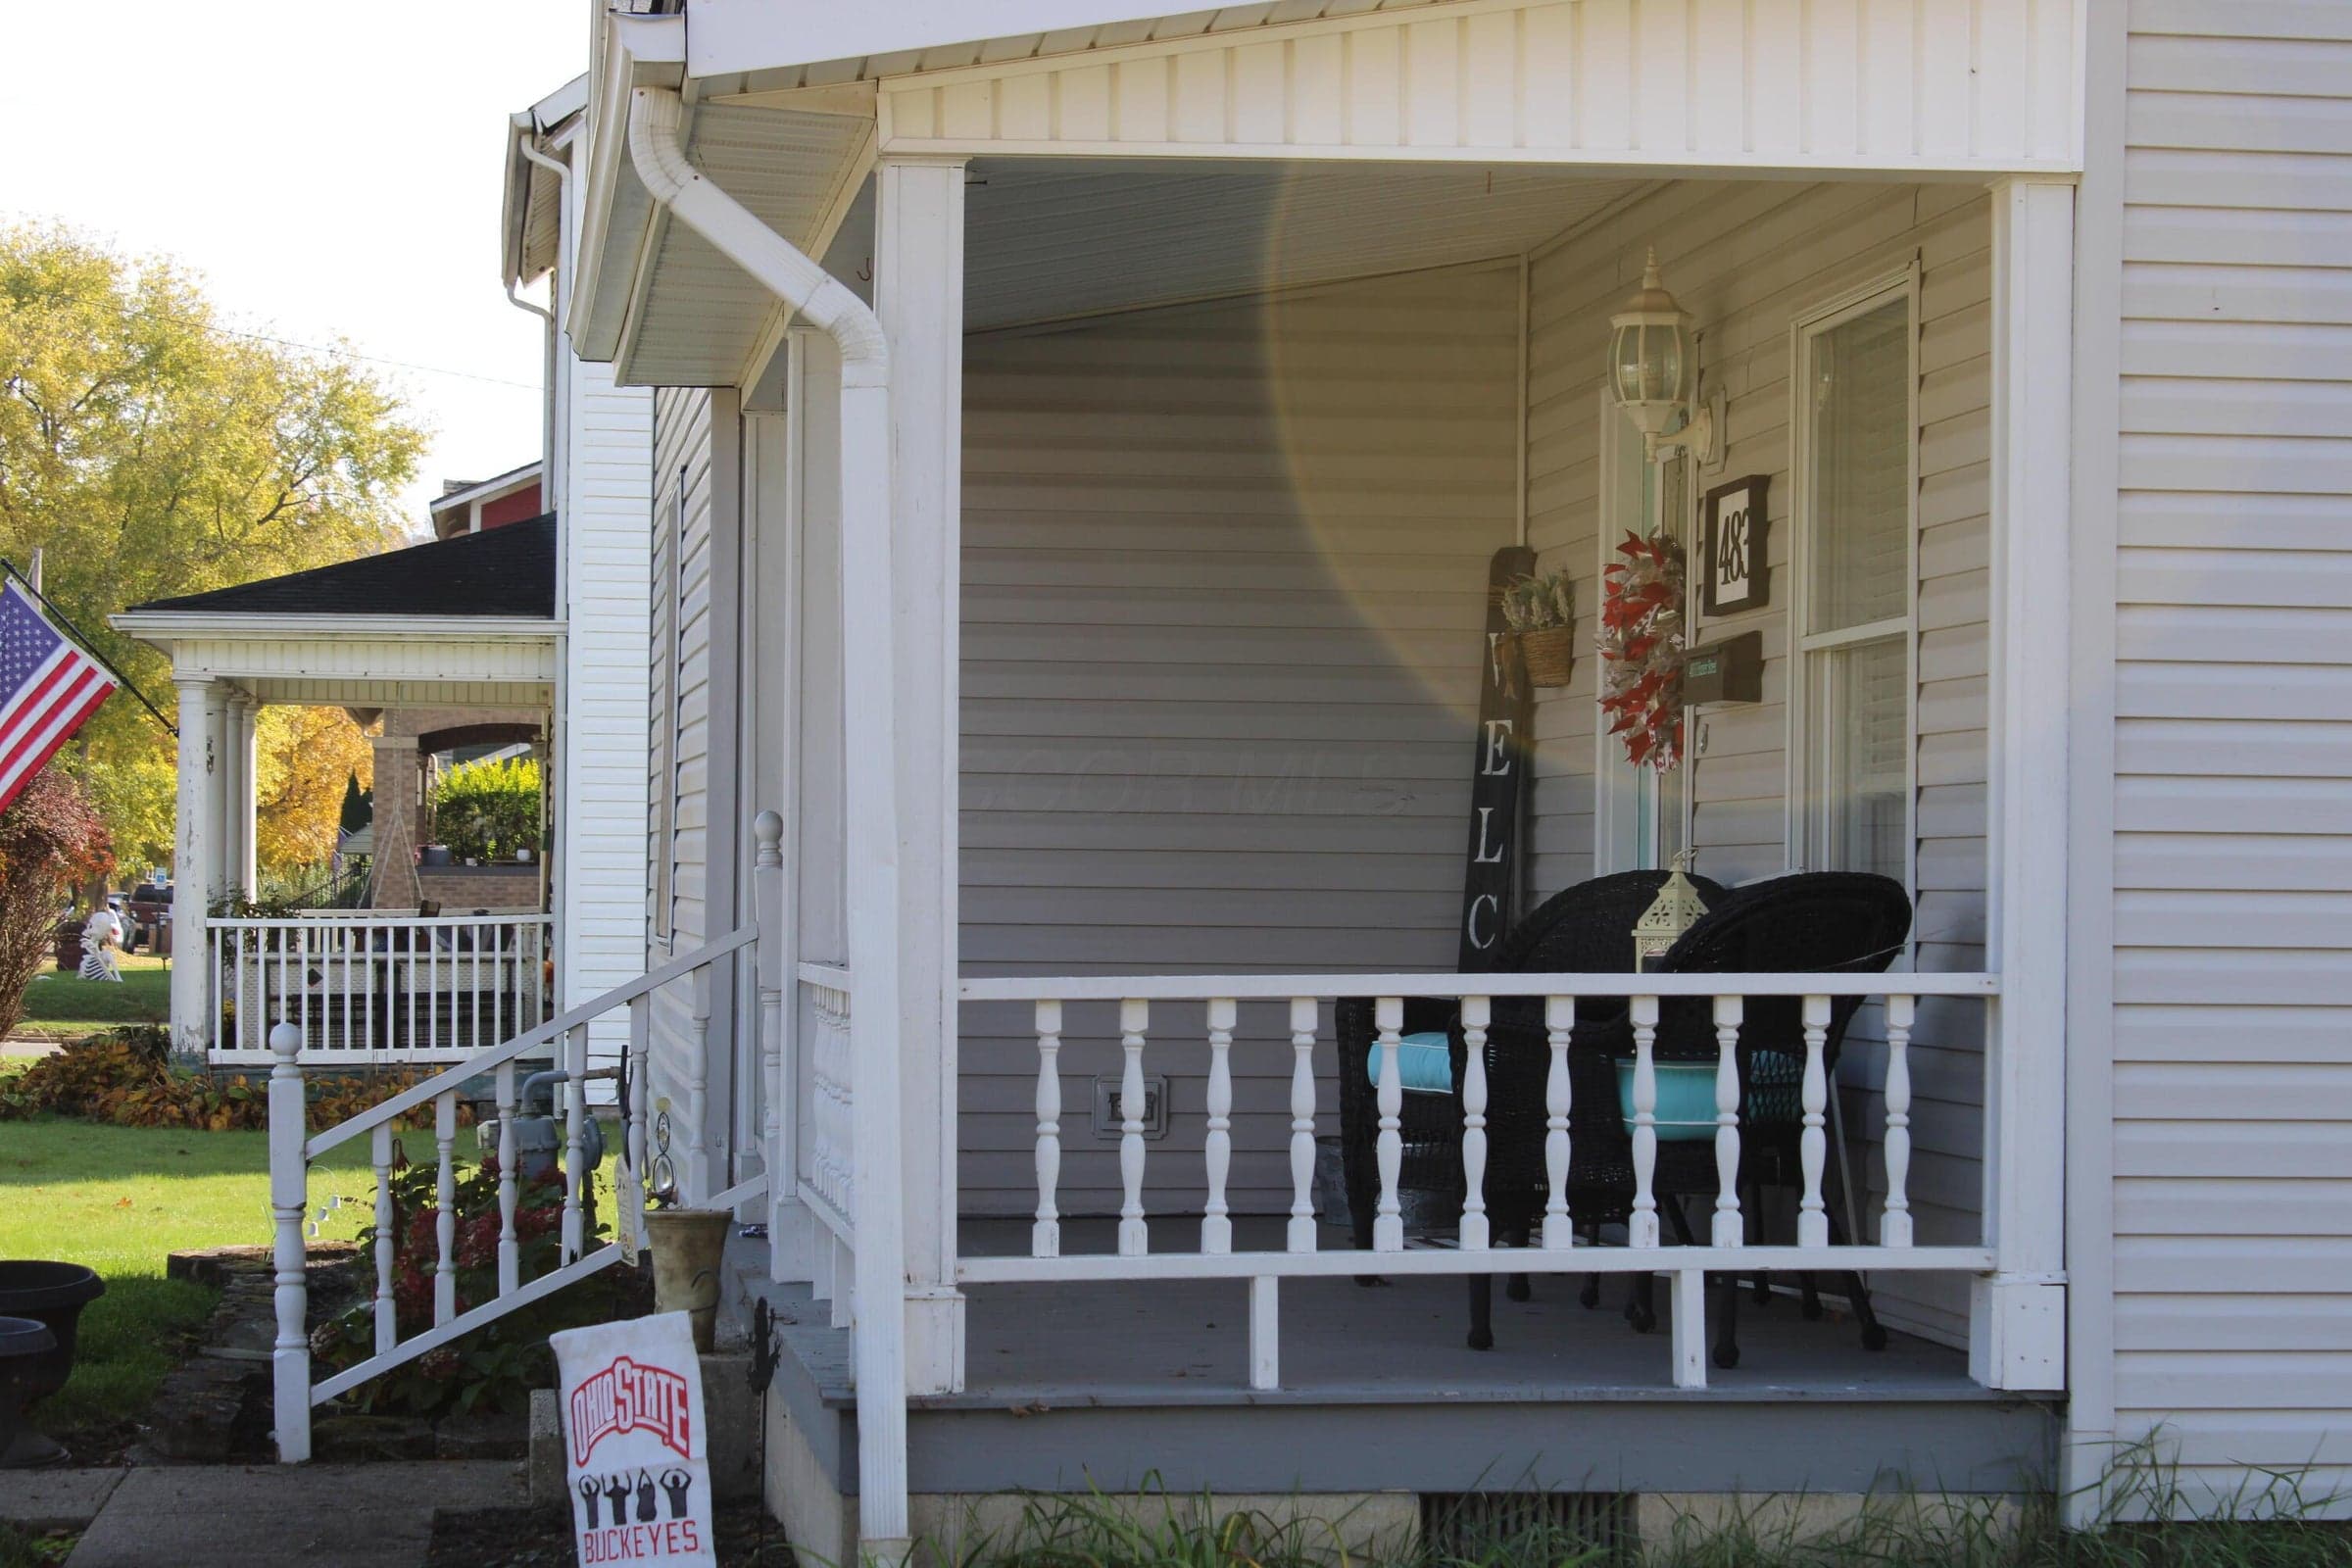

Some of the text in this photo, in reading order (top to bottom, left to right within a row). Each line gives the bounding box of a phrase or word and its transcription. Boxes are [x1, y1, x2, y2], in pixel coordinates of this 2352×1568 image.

[571, 1356, 690, 1467] OHIO STATE
[584, 1520, 699, 1564] BUCKEYES
